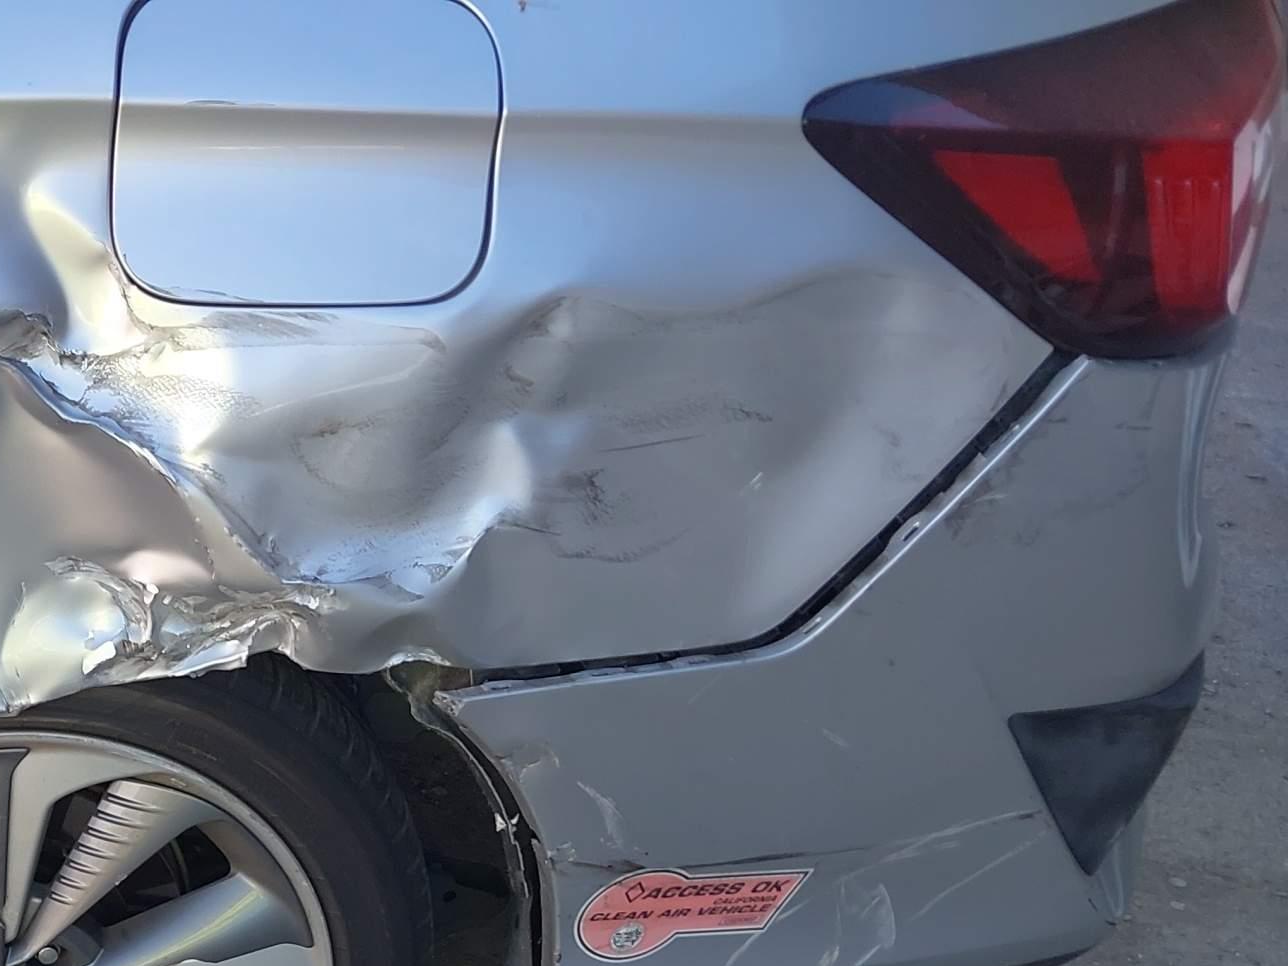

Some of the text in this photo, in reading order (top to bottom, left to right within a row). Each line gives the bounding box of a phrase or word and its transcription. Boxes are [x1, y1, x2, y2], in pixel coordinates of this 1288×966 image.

[644, 880, 790, 899] ACCESS OK
[713, 895, 777, 905] CALIFORNIA
[590, 904, 772, 921] CLEAN AIR VEHICLE
